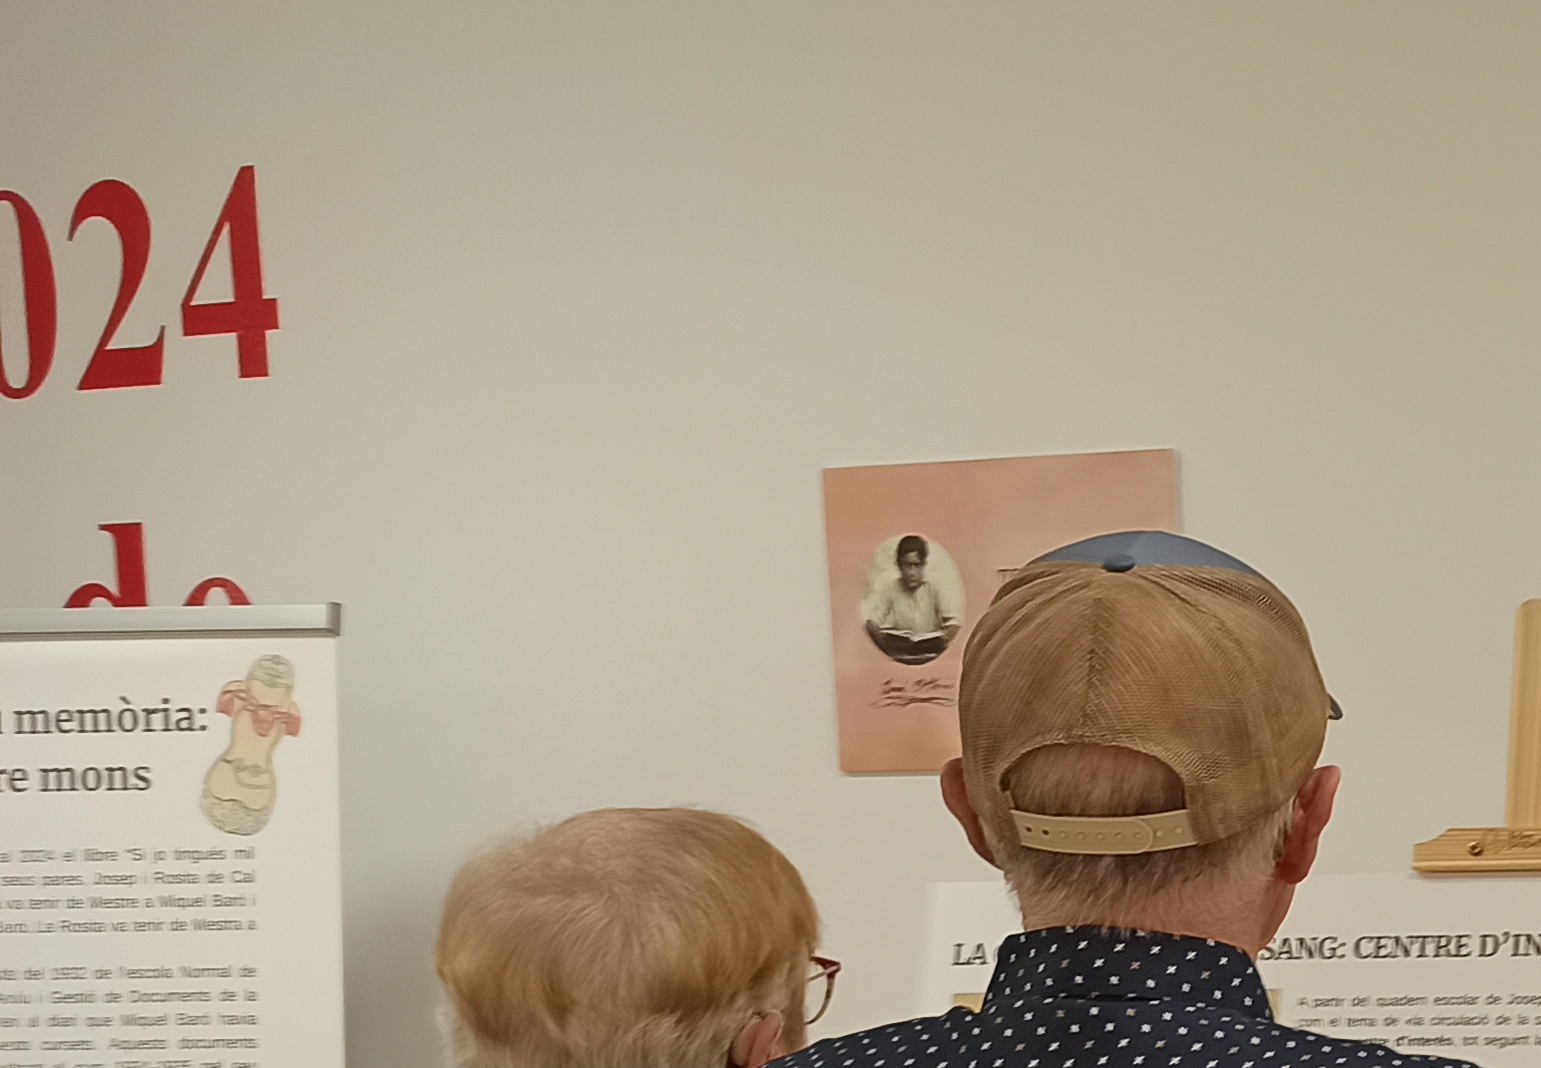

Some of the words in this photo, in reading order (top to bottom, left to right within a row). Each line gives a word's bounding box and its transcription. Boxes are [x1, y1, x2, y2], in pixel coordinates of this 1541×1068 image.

[12, 695, 208, 735] memòria:
[38, 766, 153, 793] mons
[951, 942, 990, 966] LA
[1259, 936, 1347, 961] SANG:
[1352, 934, 1473, 960] CENTRE
